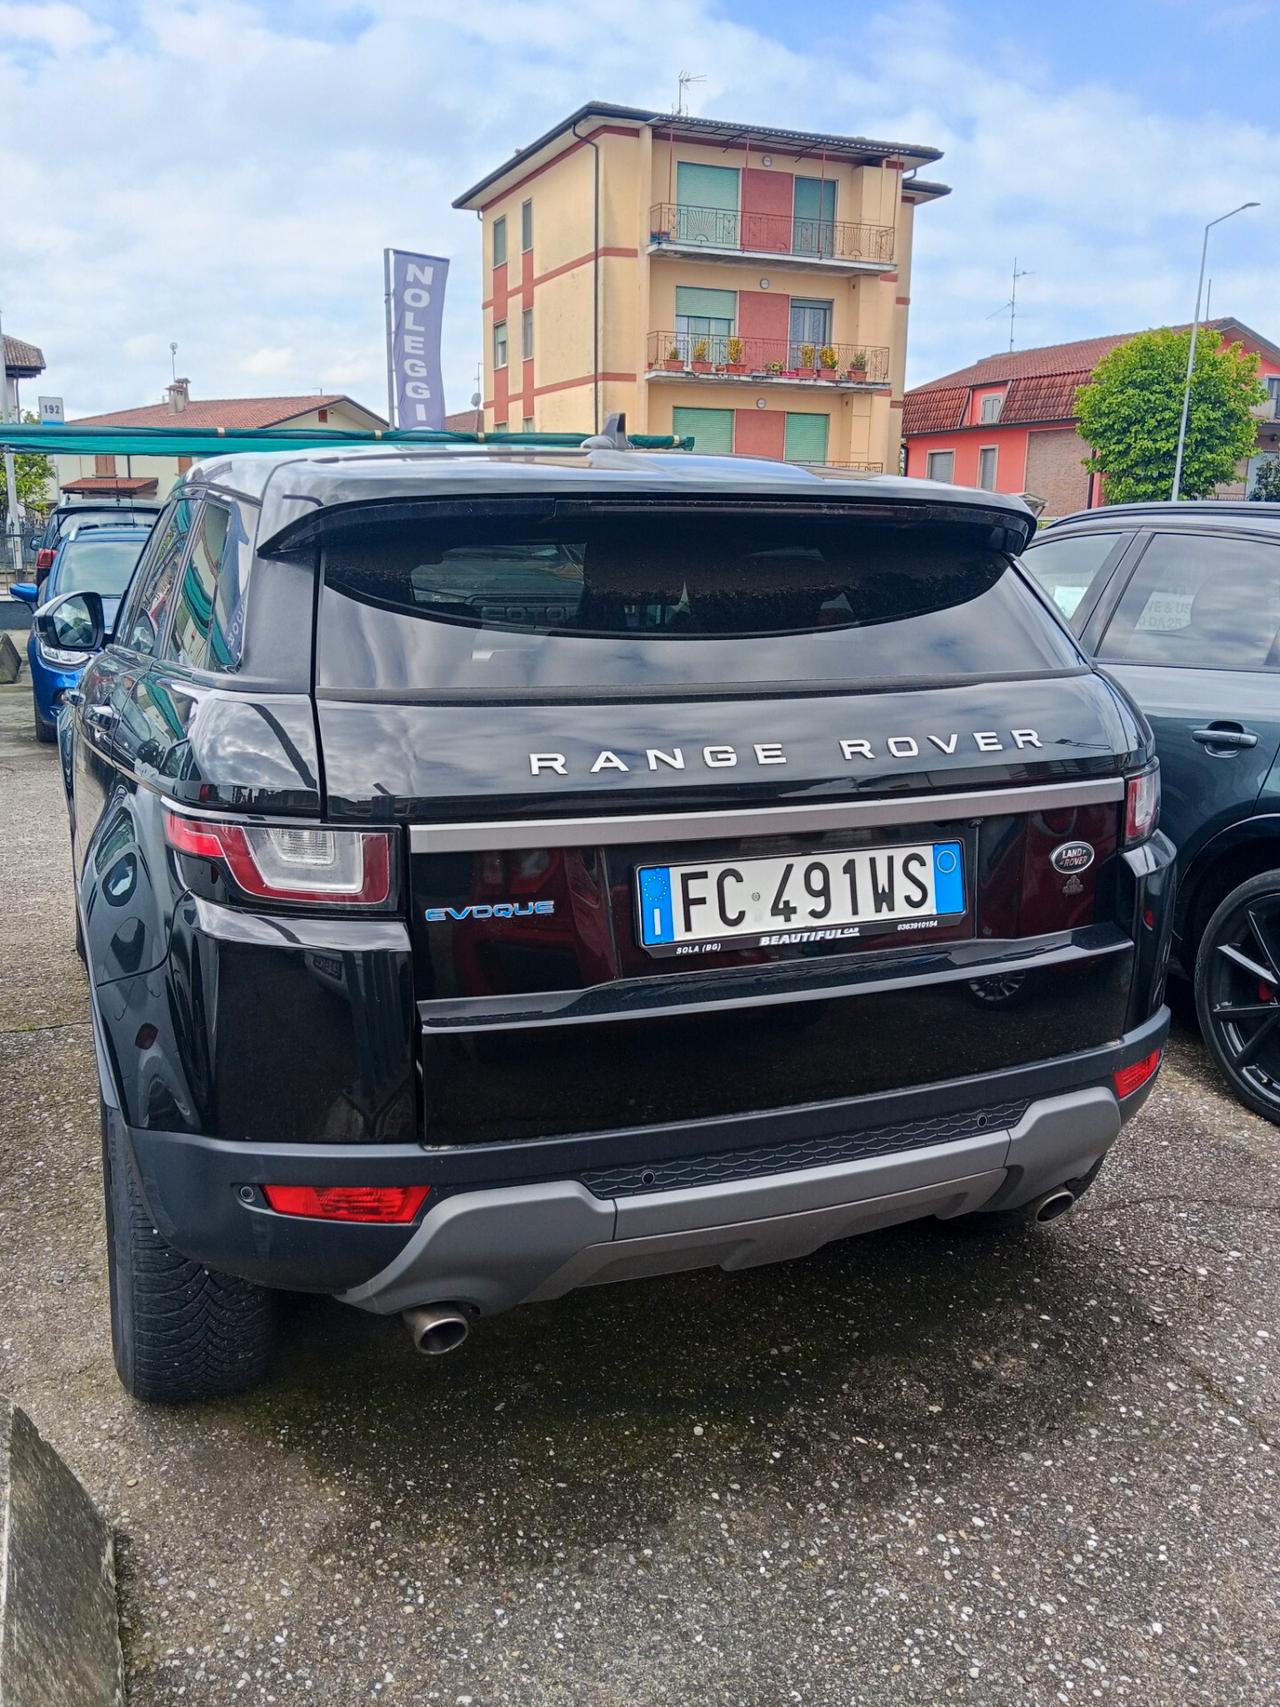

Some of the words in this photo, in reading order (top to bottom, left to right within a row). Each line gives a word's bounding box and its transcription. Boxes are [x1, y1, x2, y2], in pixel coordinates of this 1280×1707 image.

[402, 263, 434, 430] NOLEGGI
[44, 404, 60, 414] 192
[529, 743, 788, 776] RANGE
[839, 728, 1043, 760] ROVER
[1062, 848, 1082, 859] LAND
[1063, 856, 1087, 867] ROVER
[680, 868, 746, 932] FC
[770, 852, 928, 923] 491WS
[425, 900, 554, 921] EVOQUE
[759, 928, 848, 946] BEAUTIFUL
[676, 945, 700, 955] SOLA
[702, 943, 722, 953] (BG)
